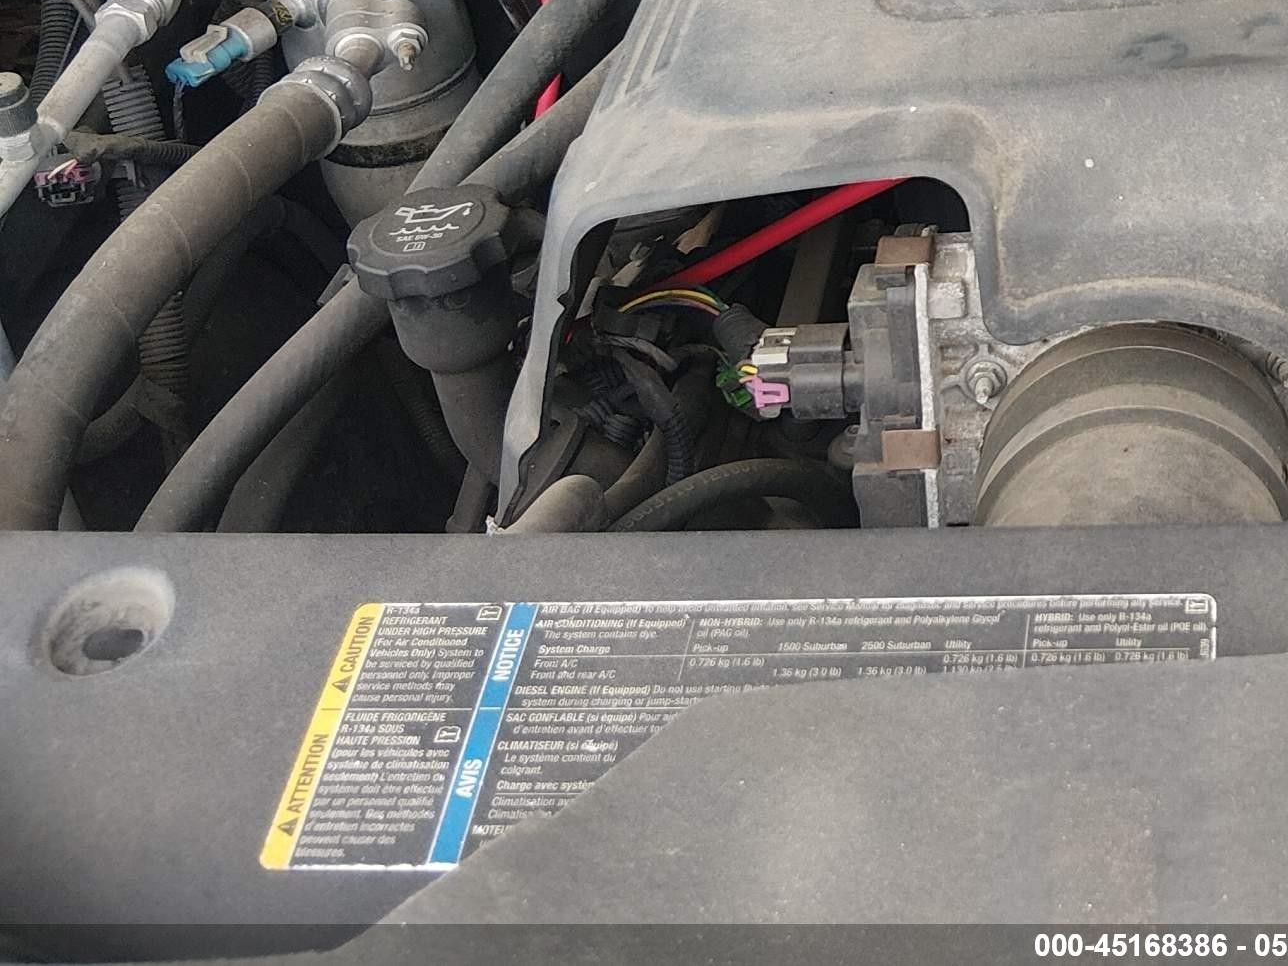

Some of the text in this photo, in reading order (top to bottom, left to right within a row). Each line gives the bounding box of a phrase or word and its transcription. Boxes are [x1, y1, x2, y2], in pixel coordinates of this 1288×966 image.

[382, 616, 448, 625] REFRIGERANT
[700, 617, 763, 626] NON-HYBRID:
[768, 617, 786, 626] Use
[787, 617, 806, 628] only
[809, 616, 842, 626] R-134a
[844, 615, 893, 626] refrigerant
[894, 615, 912, 624] and
[1035, 611, 1152, 623] HYBRID: Use only R-134a
[555, 619, 625, 628] CONDITIONING
[639, 619, 687, 629] Equipped)
[1034, 624, 1082, 634] refrigerant
[1084, 624, 1102, 632] and
[377, 626, 488, 635] UNDER HIGH PRESSURE
[544, 631, 562, 639] The
[563, 631, 597, 640] system
[598, 630, 638, 639] contains
[340, 616, 375, 673] CAUTION
[374, 637, 468, 647] (For Air Conditioned
[692, 640, 972, 653] Pick-up 1500 Suburban 2500 Suburban Utility
[1032, 637, 1142, 649] Pick-up Utility
[370, 648, 485, 658] Vehicles Only) System to
[492, 629, 525, 682] NOTICE
[539, 645, 611, 655] System Charge
[689, 657, 716, 667] 0.726
[718, 657, 730, 667] kg
[752, 657, 765, 667] lb)
[971, 654, 984, 665] kg
[1059, 652, 1072, 663] kg
[365, 659, 474, 670] be serviced by qualified
[534, 659, 578, 668] Front A/C
[360, 671, 406, 680] personnel
[530, 670, 616, 680] Front and rear A/C
[773, 668, 793, 677] 1.36
[795, 668, 807, 679] kg
[829, 667, 842, 678] lb)
[857, 666, 878, 676] 1.36
[357, 682, 455, 692] service methods may
[515, 686, 548, 695] DIESEL
[550, 685, 587, 695] ENGINE
[589, 685, 600, 696] (If
[602, 685, 651, 696] Equipped)
[653, 685, 666, 695] Do
[668, 685, 684, 694] not
[686, 685, 703, 694] use
[352, 695, 381, 703] cause
[382, 693, 423, 703] personal
[522, 697, 644, 708] system during charging or
[345, 713, 379, 722] FLUIDE
[506, 713, 527, 723] SAC
[528, 713, 585, 723] GONFLABLE
[586, 712, 599, 724] (si
[639, 712, 660, 722] Pour
[341, 724, 405, 733] R-134a SOUS
[513, 725, 565, 734] d'entretien
[567, 725, 593, 734] avant
[336, 736, 421, 746] HAUTE PRESSION
[497, 740, 579, 751] CLIMATISEUR (si
[331, 749, 359, 759] (pour
[360, 748, 375, 757] les
[426, 749, 450, 757] avec
[504, 753, 617, 764] Le système contient du
[371, 760, 384, 769] de
[286, 733, 329, 813] ATTENTION
[456, 758, 483, 799] AVIS
[496, 780, 559, 791] Charge avec
[491, 796, 555, 807] Climatisation
